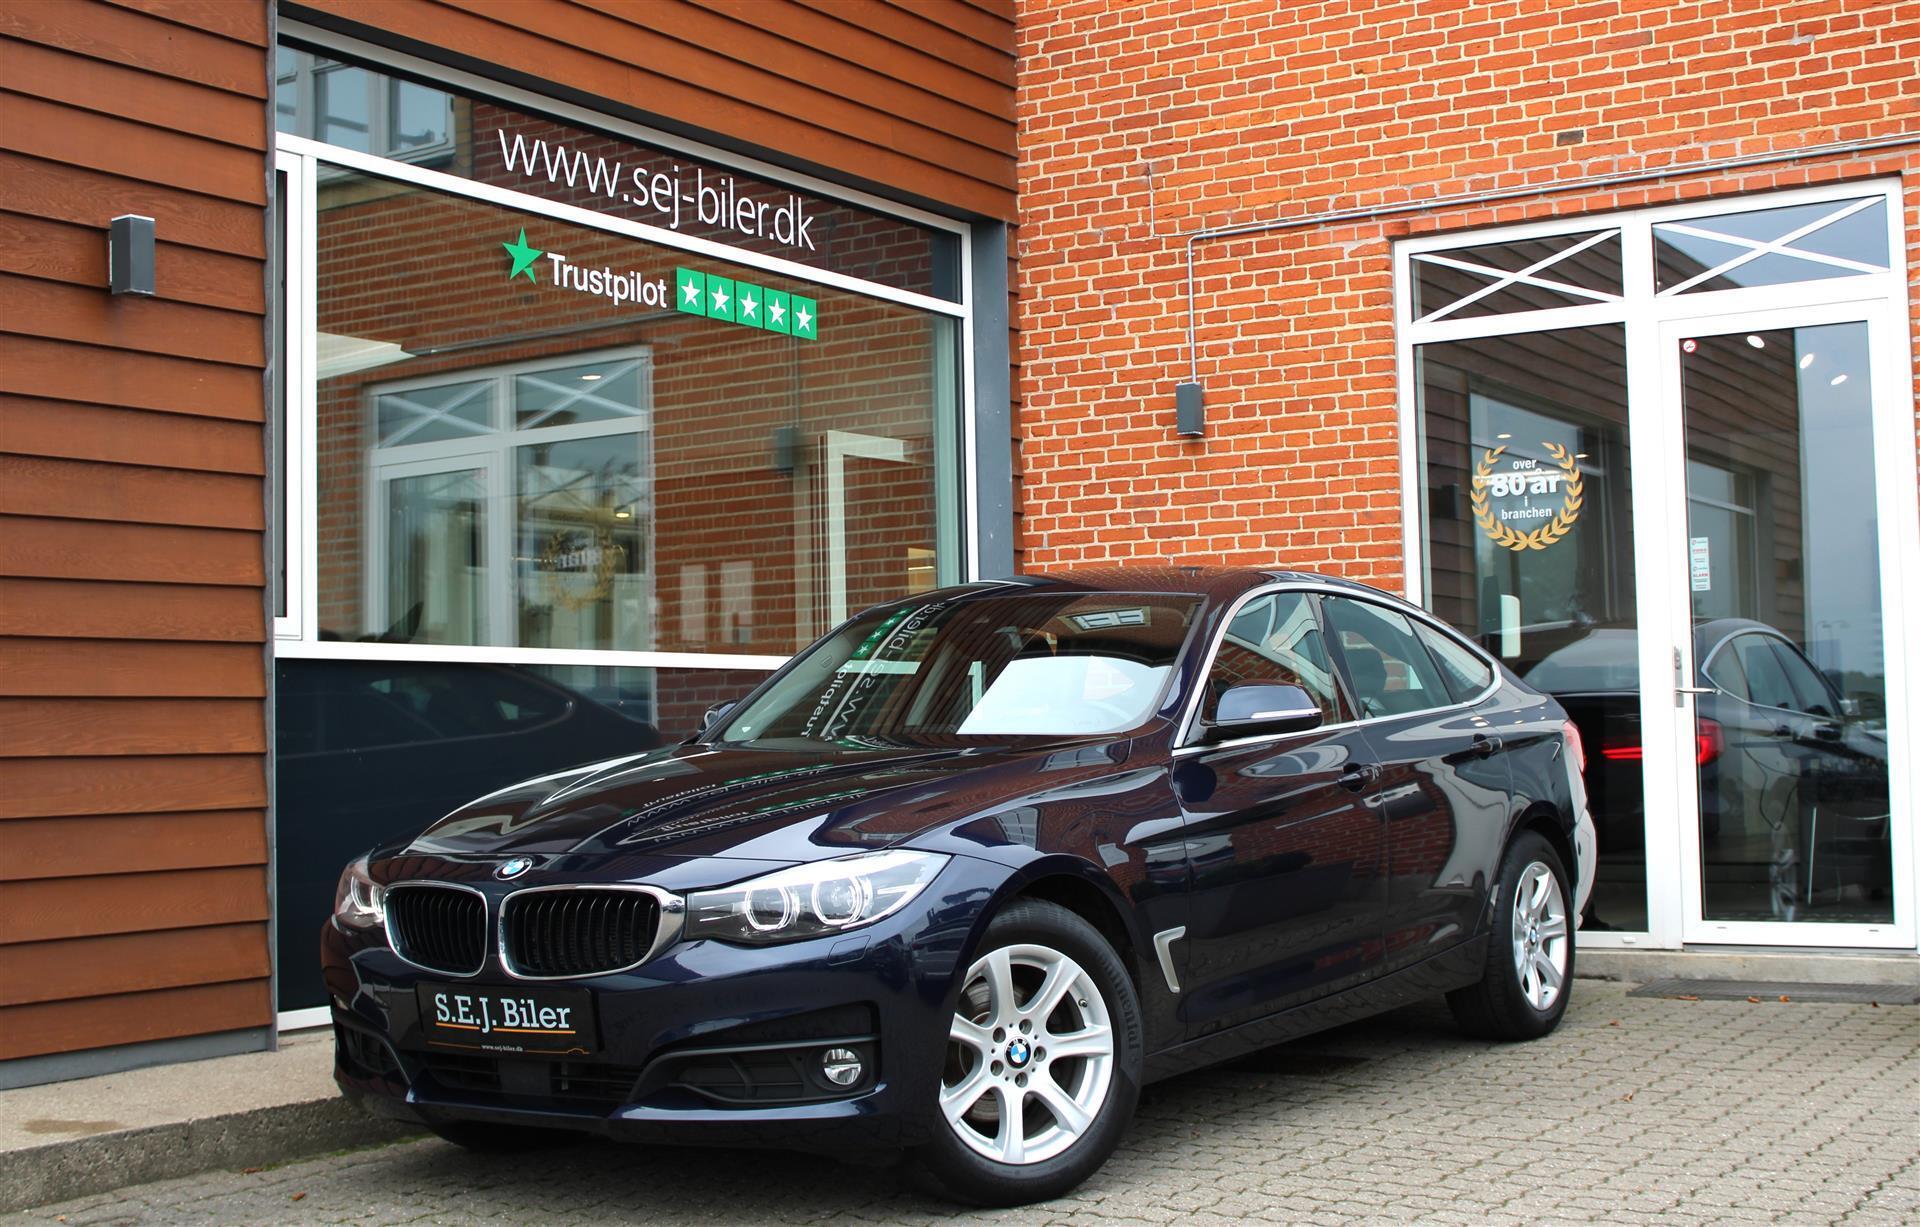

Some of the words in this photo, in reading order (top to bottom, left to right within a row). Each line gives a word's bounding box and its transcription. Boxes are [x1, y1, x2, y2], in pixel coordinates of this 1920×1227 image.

[498, 128, 816, 251] www.sej-biler.dk
[547, 252, 668, 309] Trustpilot
[1512, 459, 1537, 470] over
[1491, 472, 1526, 498] 80
[1530, 467, 1561, 495] år
[1501, 506, 1553, 520] branchen
[1524, 495, 1528, 507] i
[435, 992, 497, 1033] S.E.J.
[500, 998, 571, 1029] Biler
